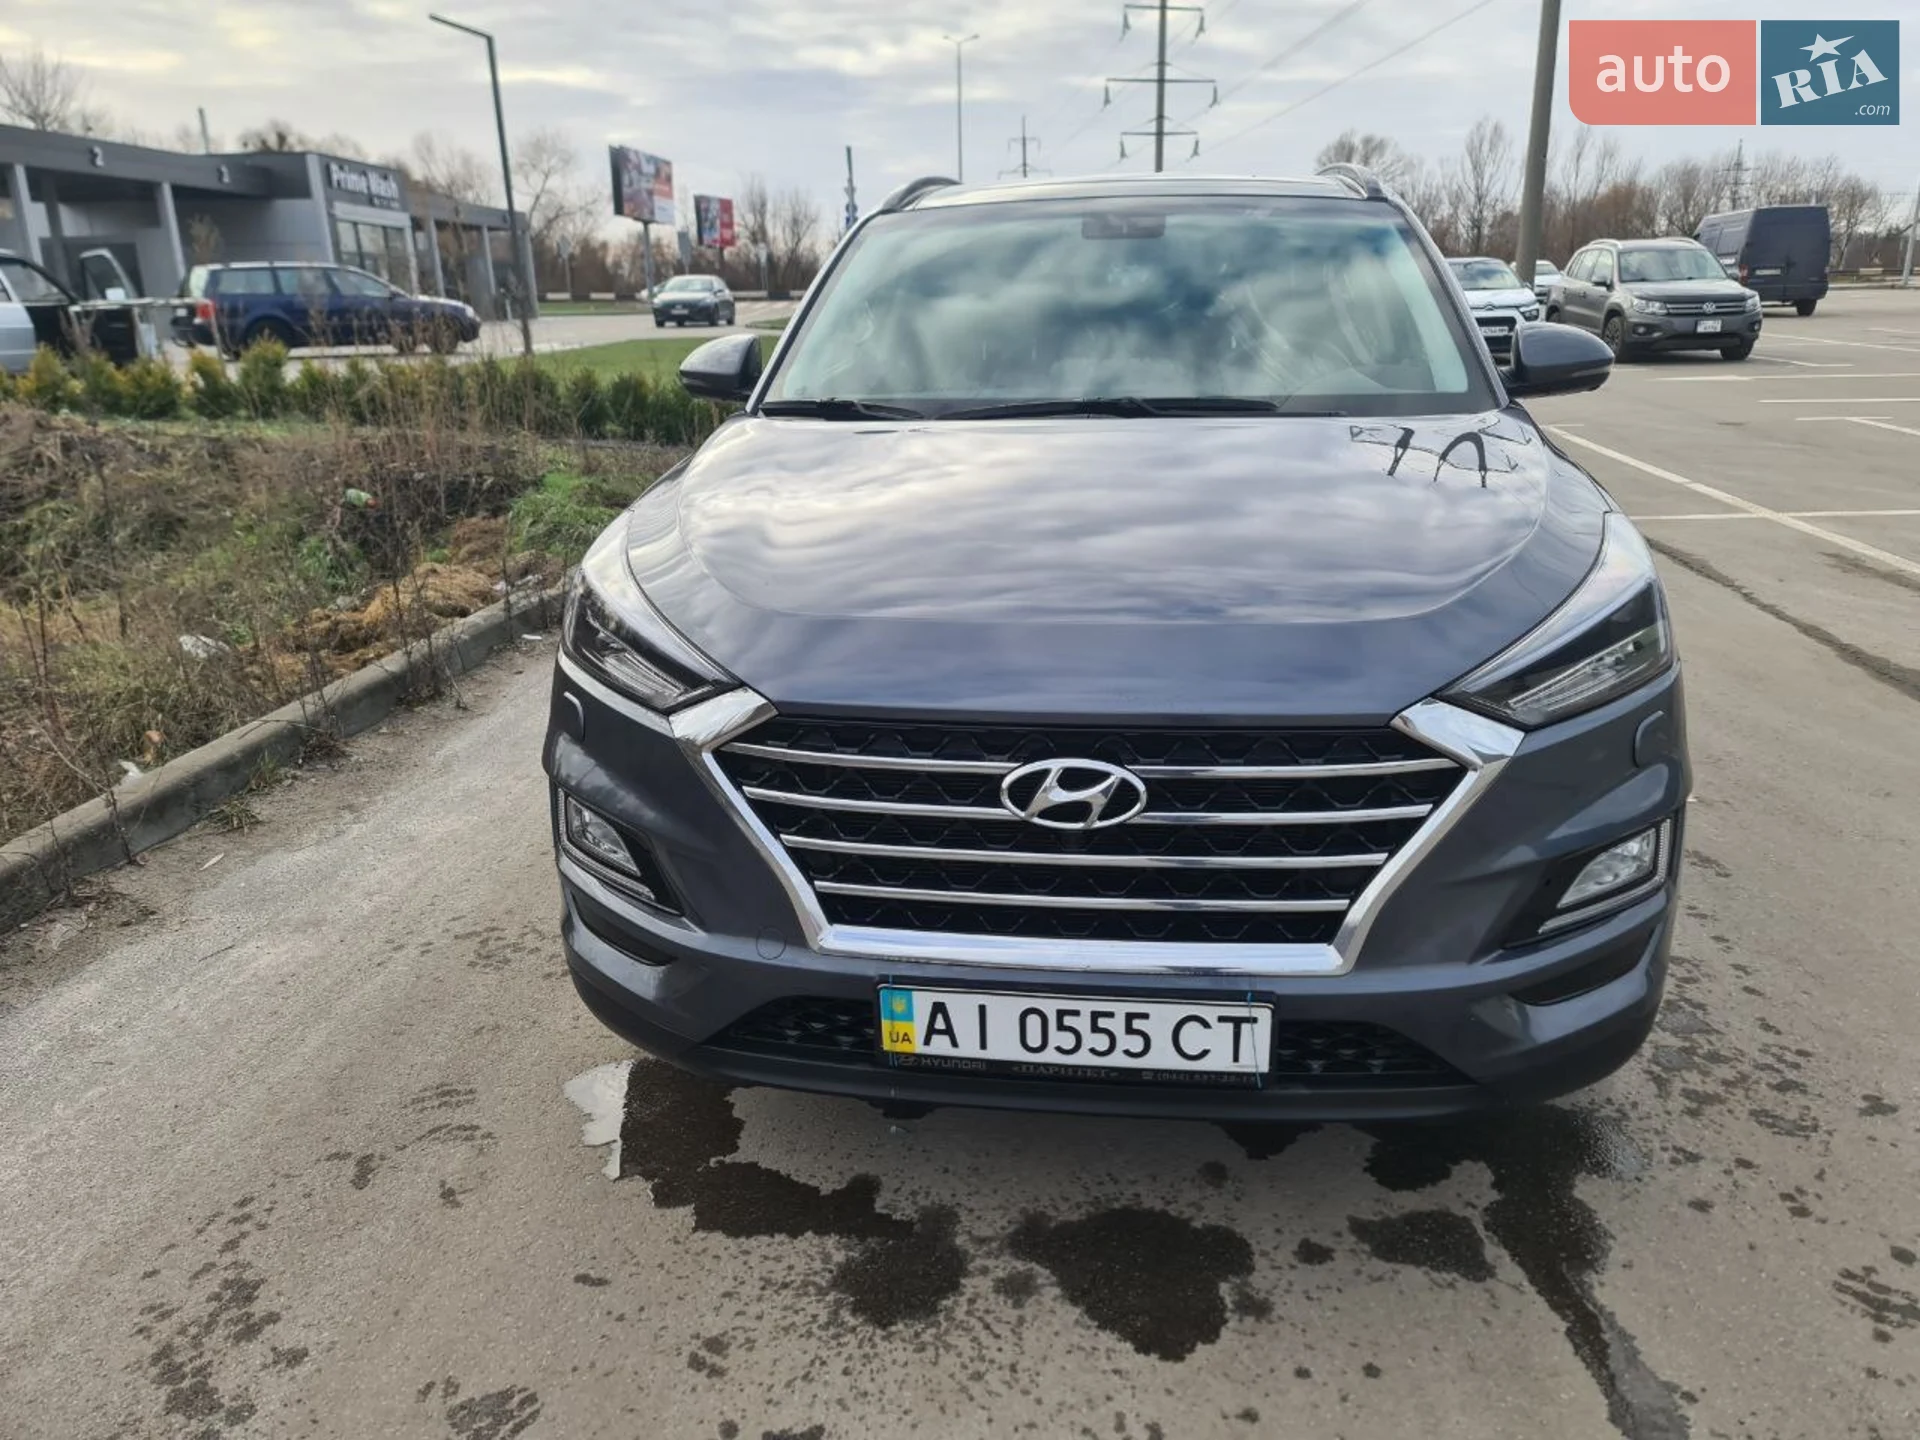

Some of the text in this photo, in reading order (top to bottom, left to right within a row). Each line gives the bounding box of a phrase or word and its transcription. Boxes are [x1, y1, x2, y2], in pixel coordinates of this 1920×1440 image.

[889, 1030, 913, 1045] UA
[922, 1001, 1259, 1064] AI 0555 CT
